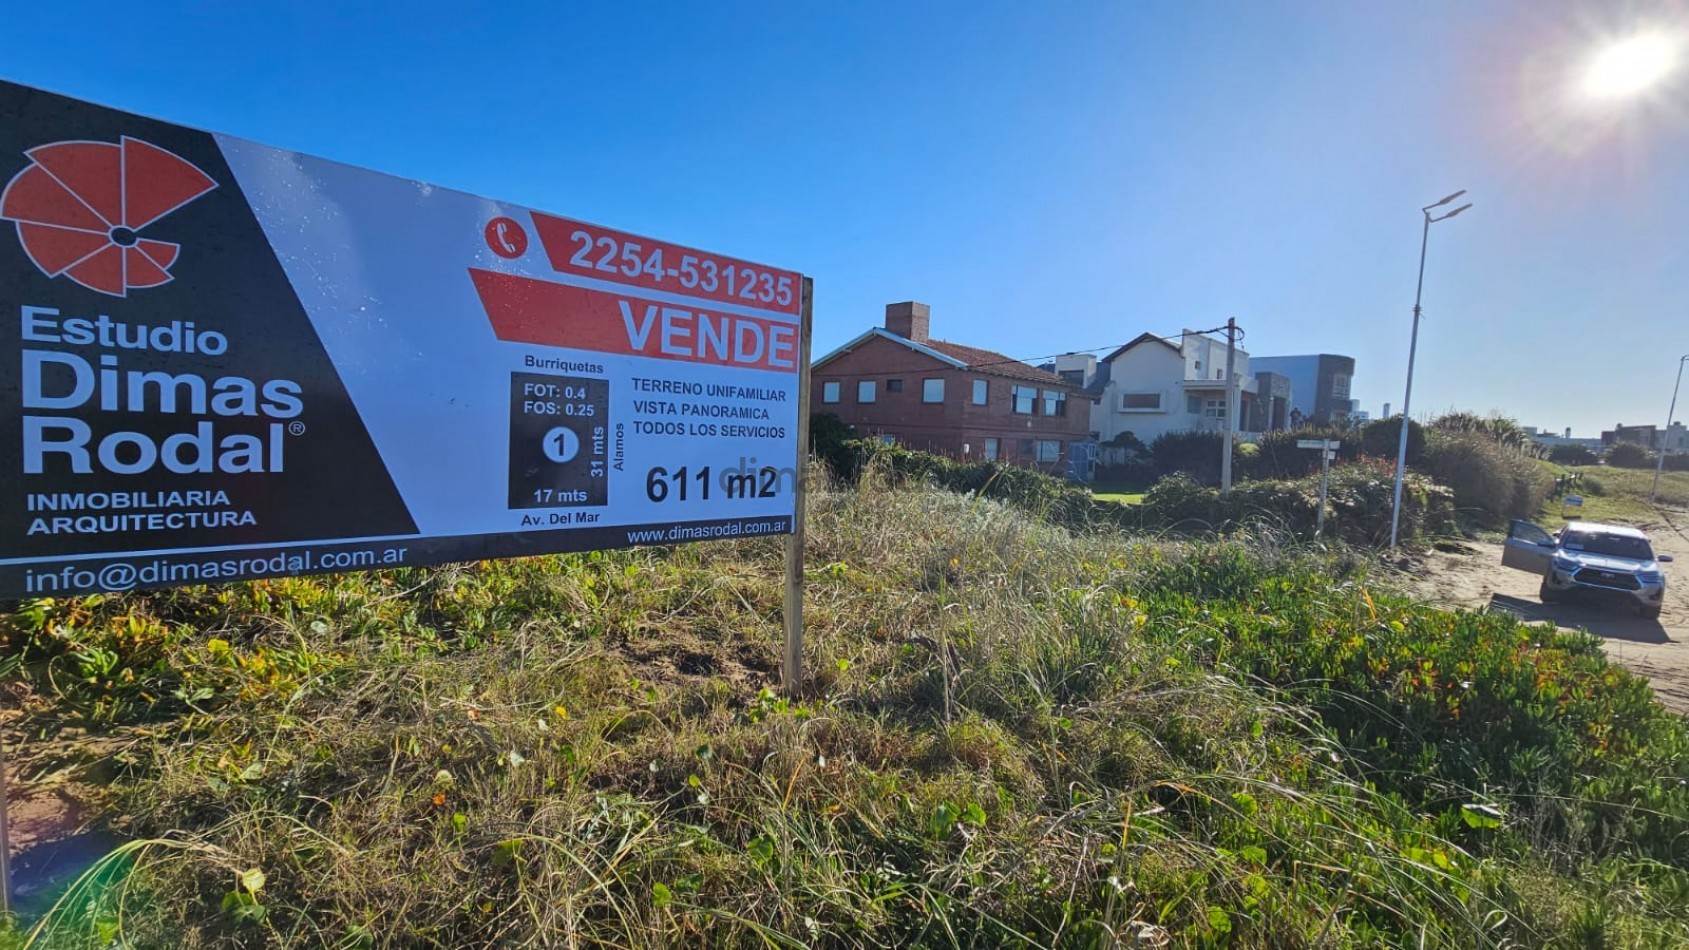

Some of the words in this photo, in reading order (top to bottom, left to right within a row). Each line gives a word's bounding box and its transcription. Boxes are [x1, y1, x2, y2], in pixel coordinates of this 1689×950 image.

[569, 230, 793, 306] 2254-531235
[21, 305, 228, 355] Estudio
[619, 300, 795, 368] VENDE
[525, 355, 604, 374] Burriquetas
[22, 349, 304, 418] Dimas
[524, 383, 561, 398] FOT:
[565, 386, 587, 400] 0.4
[631, 377, 703, 395] TERRENO
[706, 384, 786, 402] UNIFAMILIAR
[524, 401, 561, 415] FOS:
[565, 403, 595, 416] 0.25
[633, 400, 678, 415] VISTA
[682, 403, 770, 420] PANORAMICA
[592, 426, 604, 455] mts
[633, 420, 685, 436] TODOS
[690, 423, 717, 437] LOS
[721, 425, 786, 439] SERVICIOS
[553, 433, 565, 457] 1
[613, 423, 624, 471] Alamos
[591, 461, 604, 477] 31
[534, 489, 553, 502] 17
[558, 489, 588, 502] mts
[646, 465, 711, 503] 611
[727, 465, 777, 500] m2
[27, 490, 231, 511] INMOBILIARIA
[27, 510, 257, 535] ARQUITECTURA
[521, 514, 545, 526] Av.
[550, 513, 571, 524] Del
[576, 511, 600, 523] Mar
[627, 520, 786, 544] www.dimasrodal.com.ar
[26, 546, 408, 593] info@dimasrodal.com.ar
